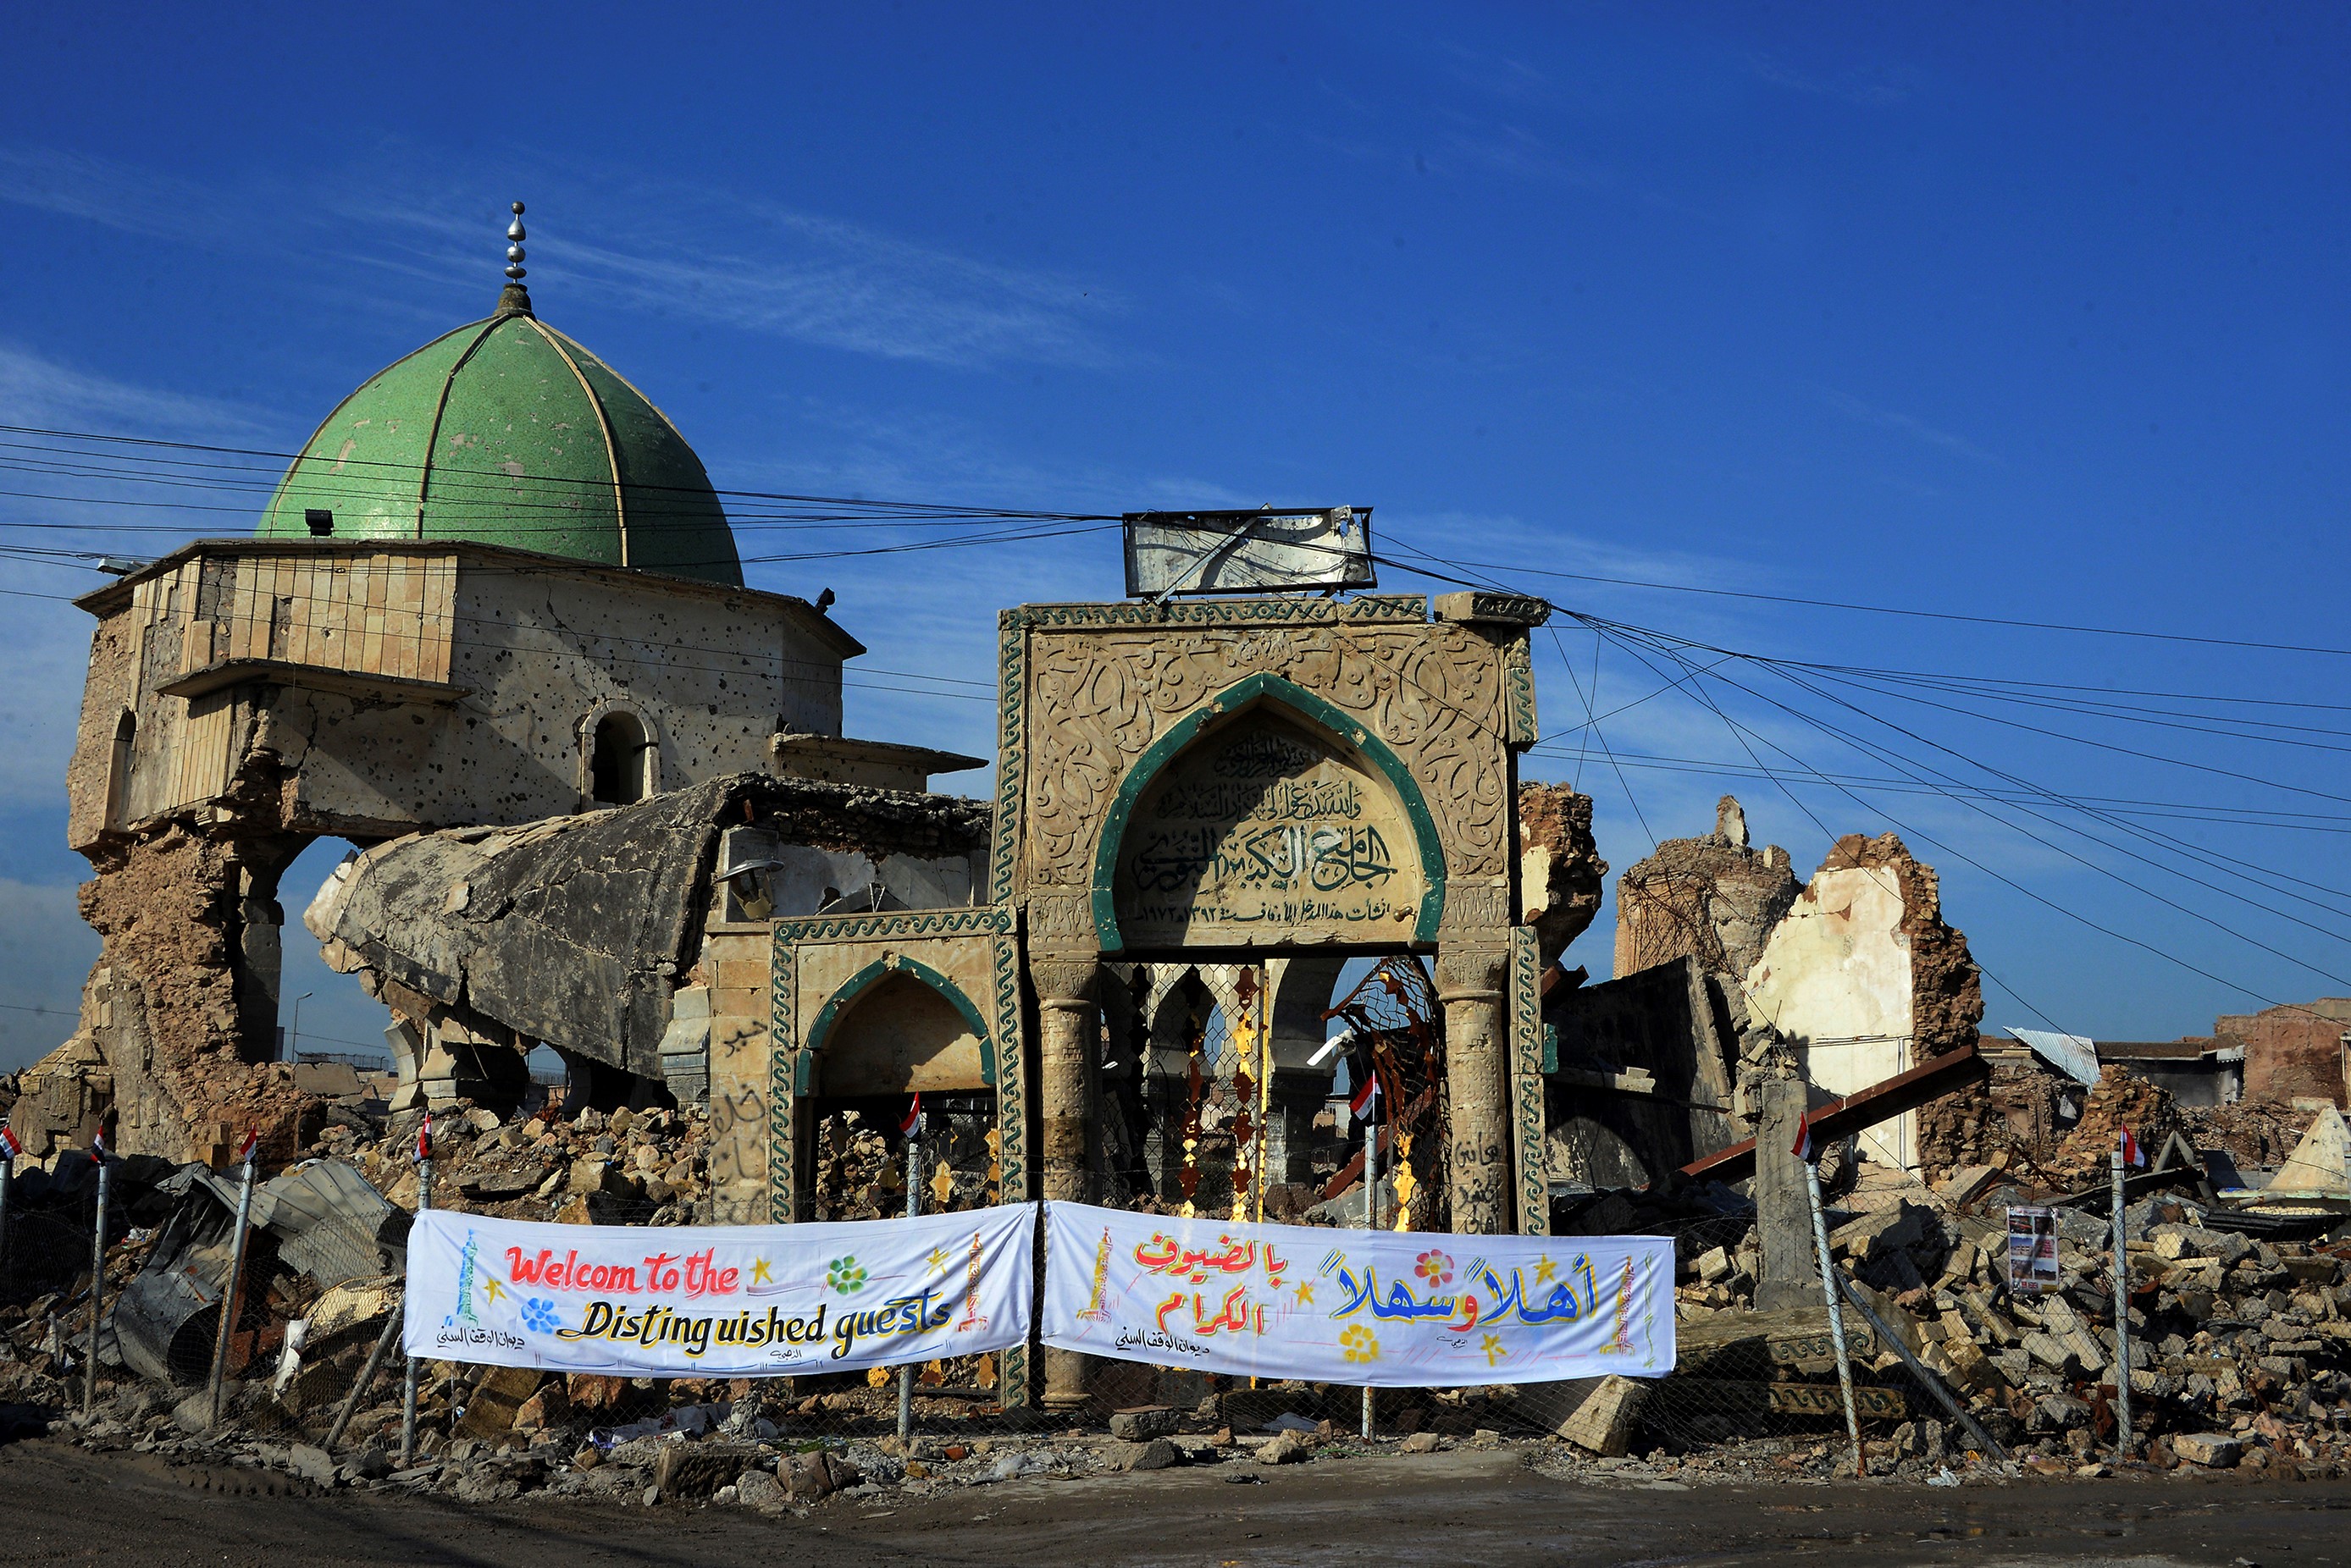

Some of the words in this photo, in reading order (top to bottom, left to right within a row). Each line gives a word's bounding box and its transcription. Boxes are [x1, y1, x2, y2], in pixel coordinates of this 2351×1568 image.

[1131, 826, 1220, 893] النوري
[1223, 825, 1307, 890] الكبير
[1311, 824, 1397, 892] الجامع
[1325, 902, 1343, 920] هذا
[505, 1245, 642, 1295] Welcom
[643, 1252, 681, 1292] to
[683, 1246, 739, 1300] the
[1134, 1231, 1289, 1289] بالضيوف
[830, 1287, 953, 1361] guests
[1156, 1283, 1270, 1338] الكرام
